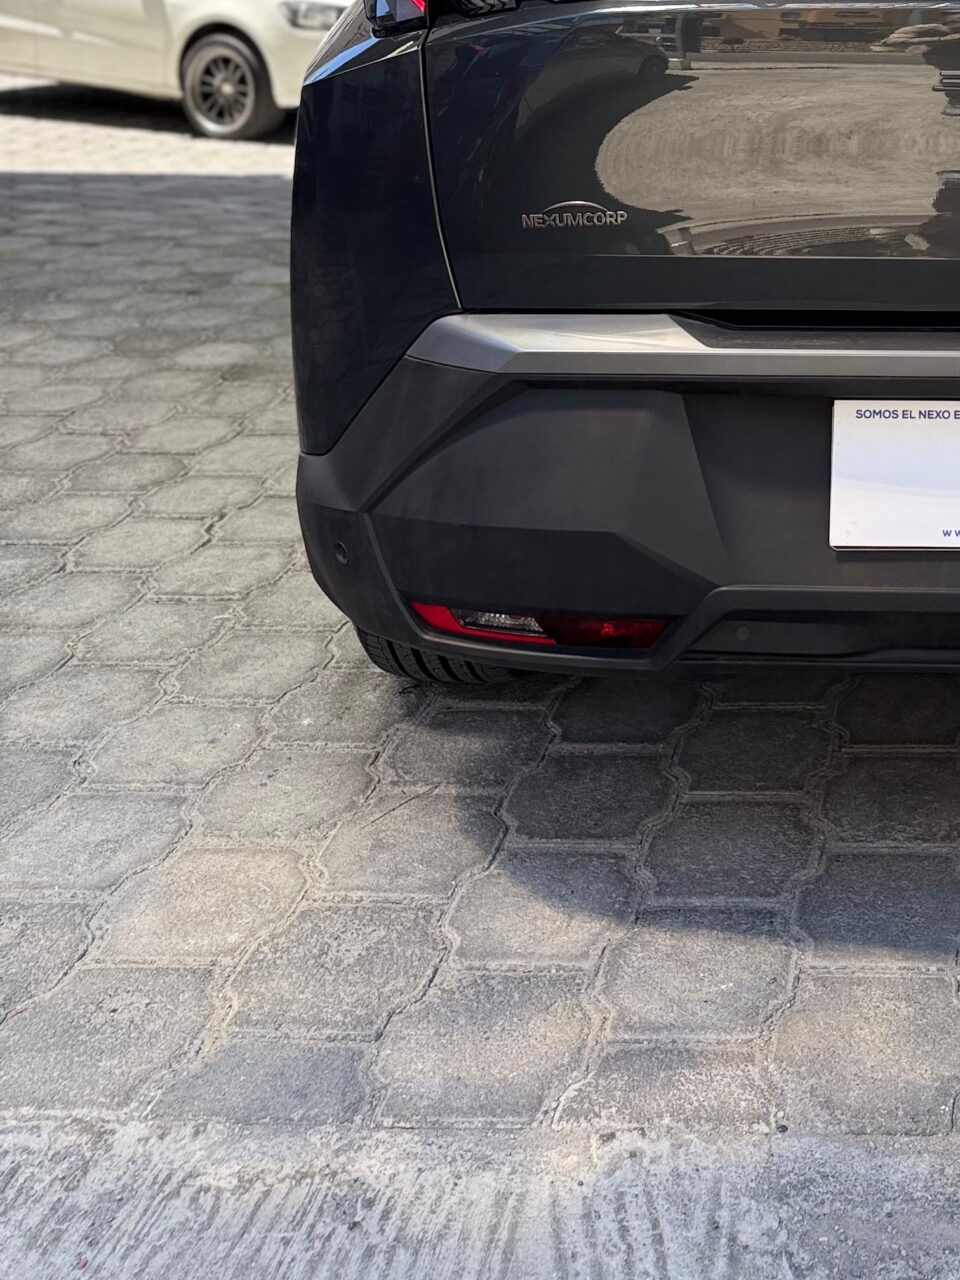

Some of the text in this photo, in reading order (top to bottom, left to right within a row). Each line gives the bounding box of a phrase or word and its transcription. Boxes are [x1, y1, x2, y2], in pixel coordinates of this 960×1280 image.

[521, 210, 628, 228] NEXUMCORP
[855, 409, 899, 419] SOMOS
[902, 409, 916, 419] EL
[918, 410, 951, 419] NEXO
